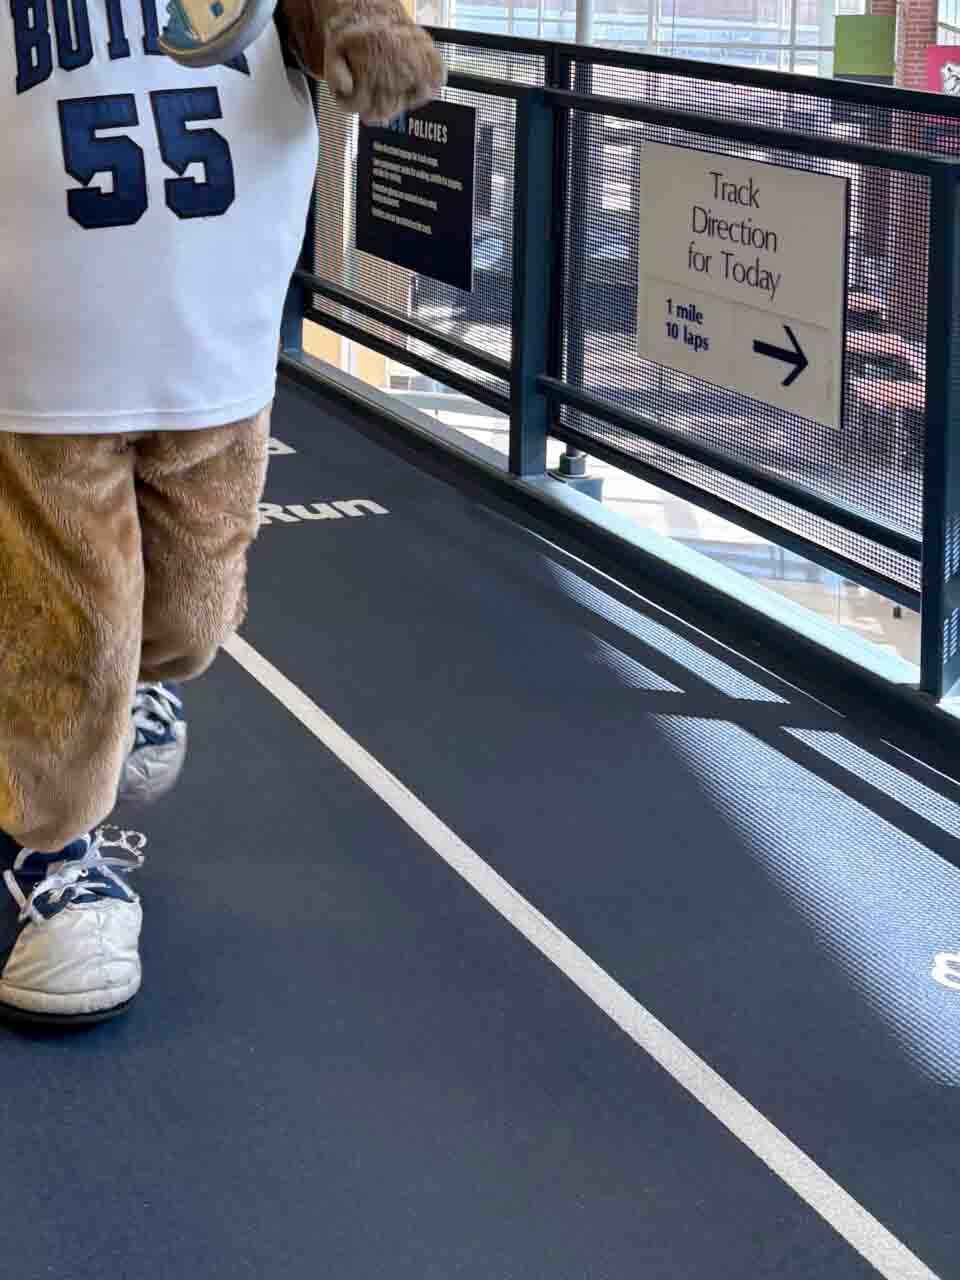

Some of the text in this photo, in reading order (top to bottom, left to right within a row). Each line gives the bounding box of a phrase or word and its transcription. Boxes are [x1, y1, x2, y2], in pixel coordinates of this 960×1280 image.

[408, 116, 449, 145] POLICIES
[57, 85, 236, 230] 55
[709, 170, 760, 209] Track
[691, 205, 778, 253] Direction
[688, 241, 781, 301] for Today
[666, 298, 704, 326] 1 mile
[666, 322, 710, 353] 10 laps
[257, 499, 391, 523] Run
